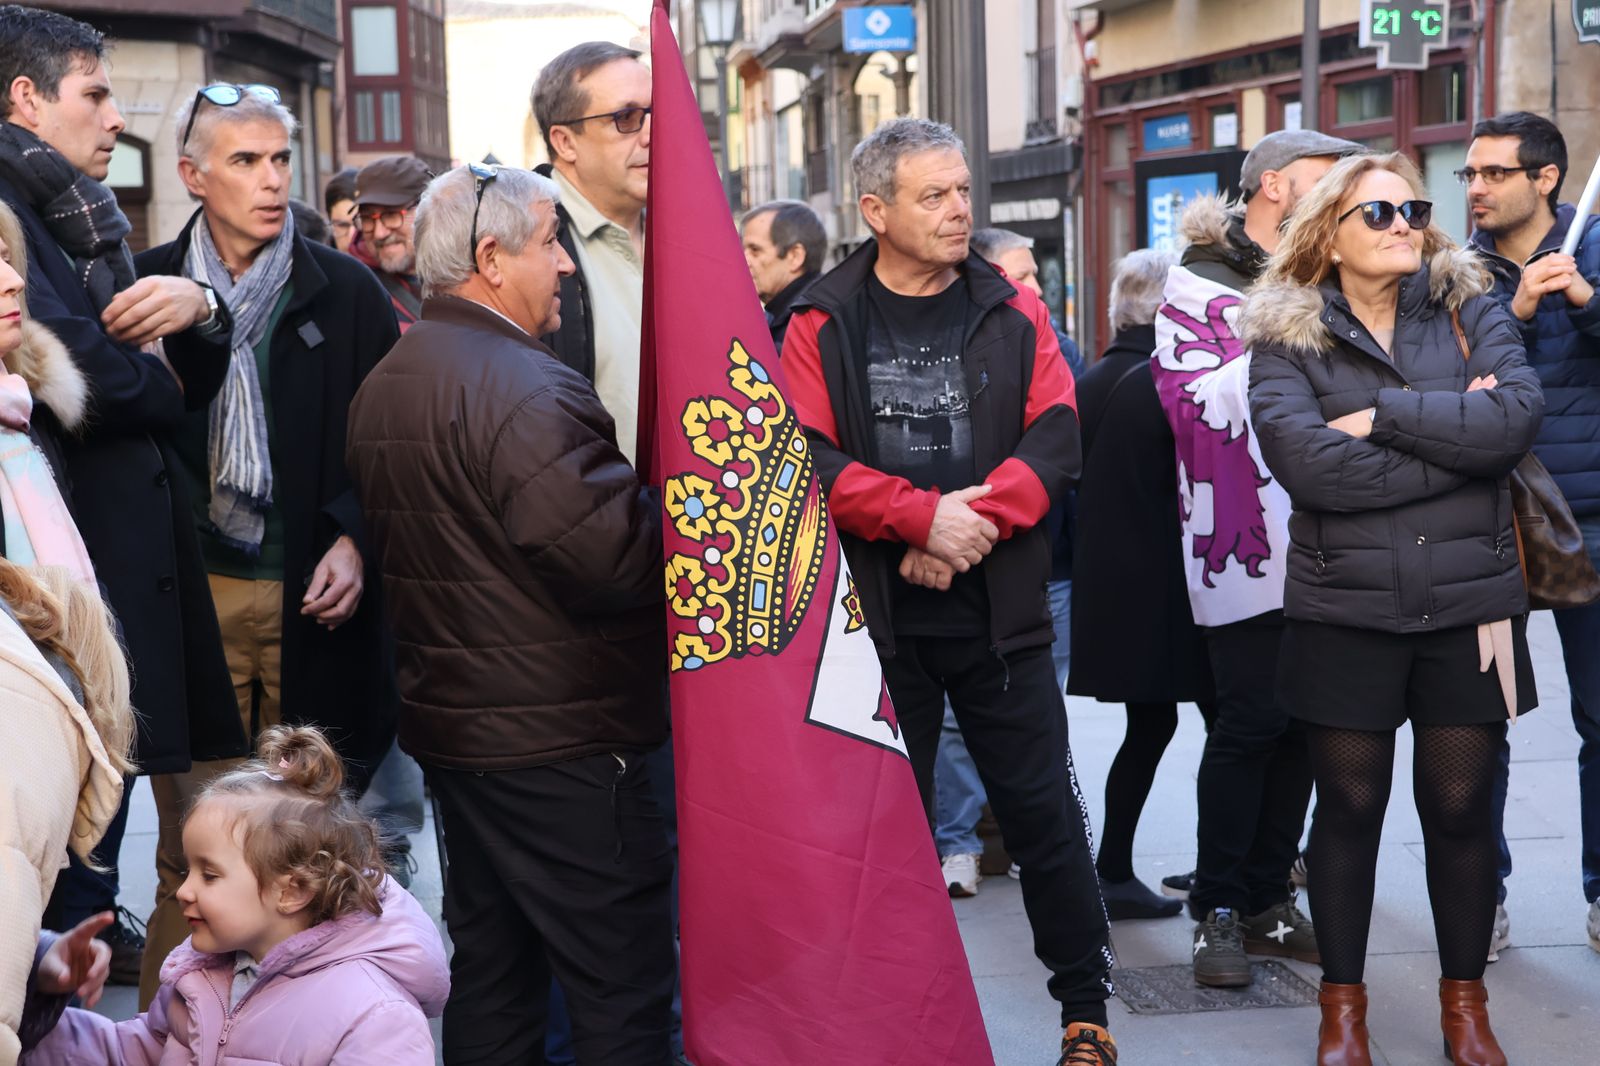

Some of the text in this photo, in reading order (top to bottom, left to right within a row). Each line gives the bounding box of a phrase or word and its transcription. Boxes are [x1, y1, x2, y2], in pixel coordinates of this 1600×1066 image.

[1373, 8, 1400, 35] 21
[1067, 766, 1079, 796] FILA
[1083, 817, 1094, 848] FILA
